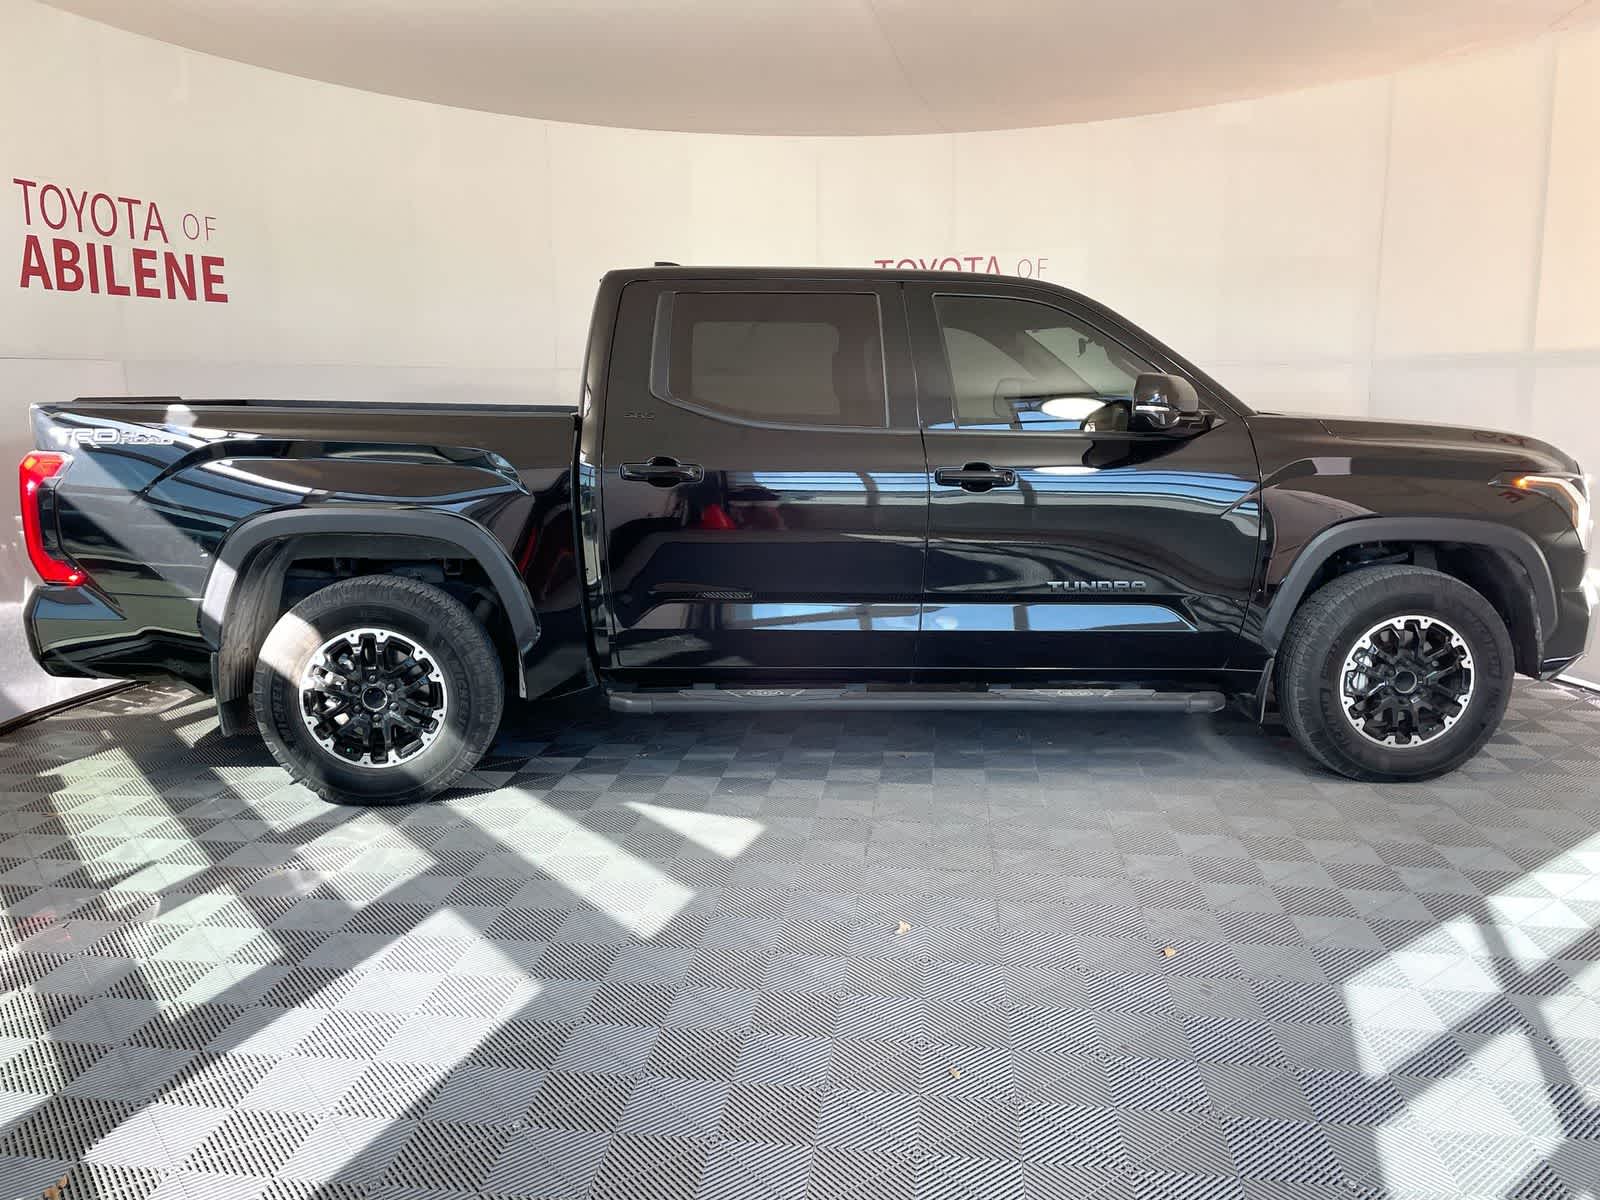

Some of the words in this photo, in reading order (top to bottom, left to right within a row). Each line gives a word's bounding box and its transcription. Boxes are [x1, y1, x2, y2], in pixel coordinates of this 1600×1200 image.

[13, 178, 169, 243] TOYOTA
[182, 213, 217, 241] OF
[20, 234, 229, 303] ABILENE
[874, 256, 1001, 275] OTA
[1018, 258, 1049, 280] OF
[1047, 581, 1146, 592] TUNDRA
